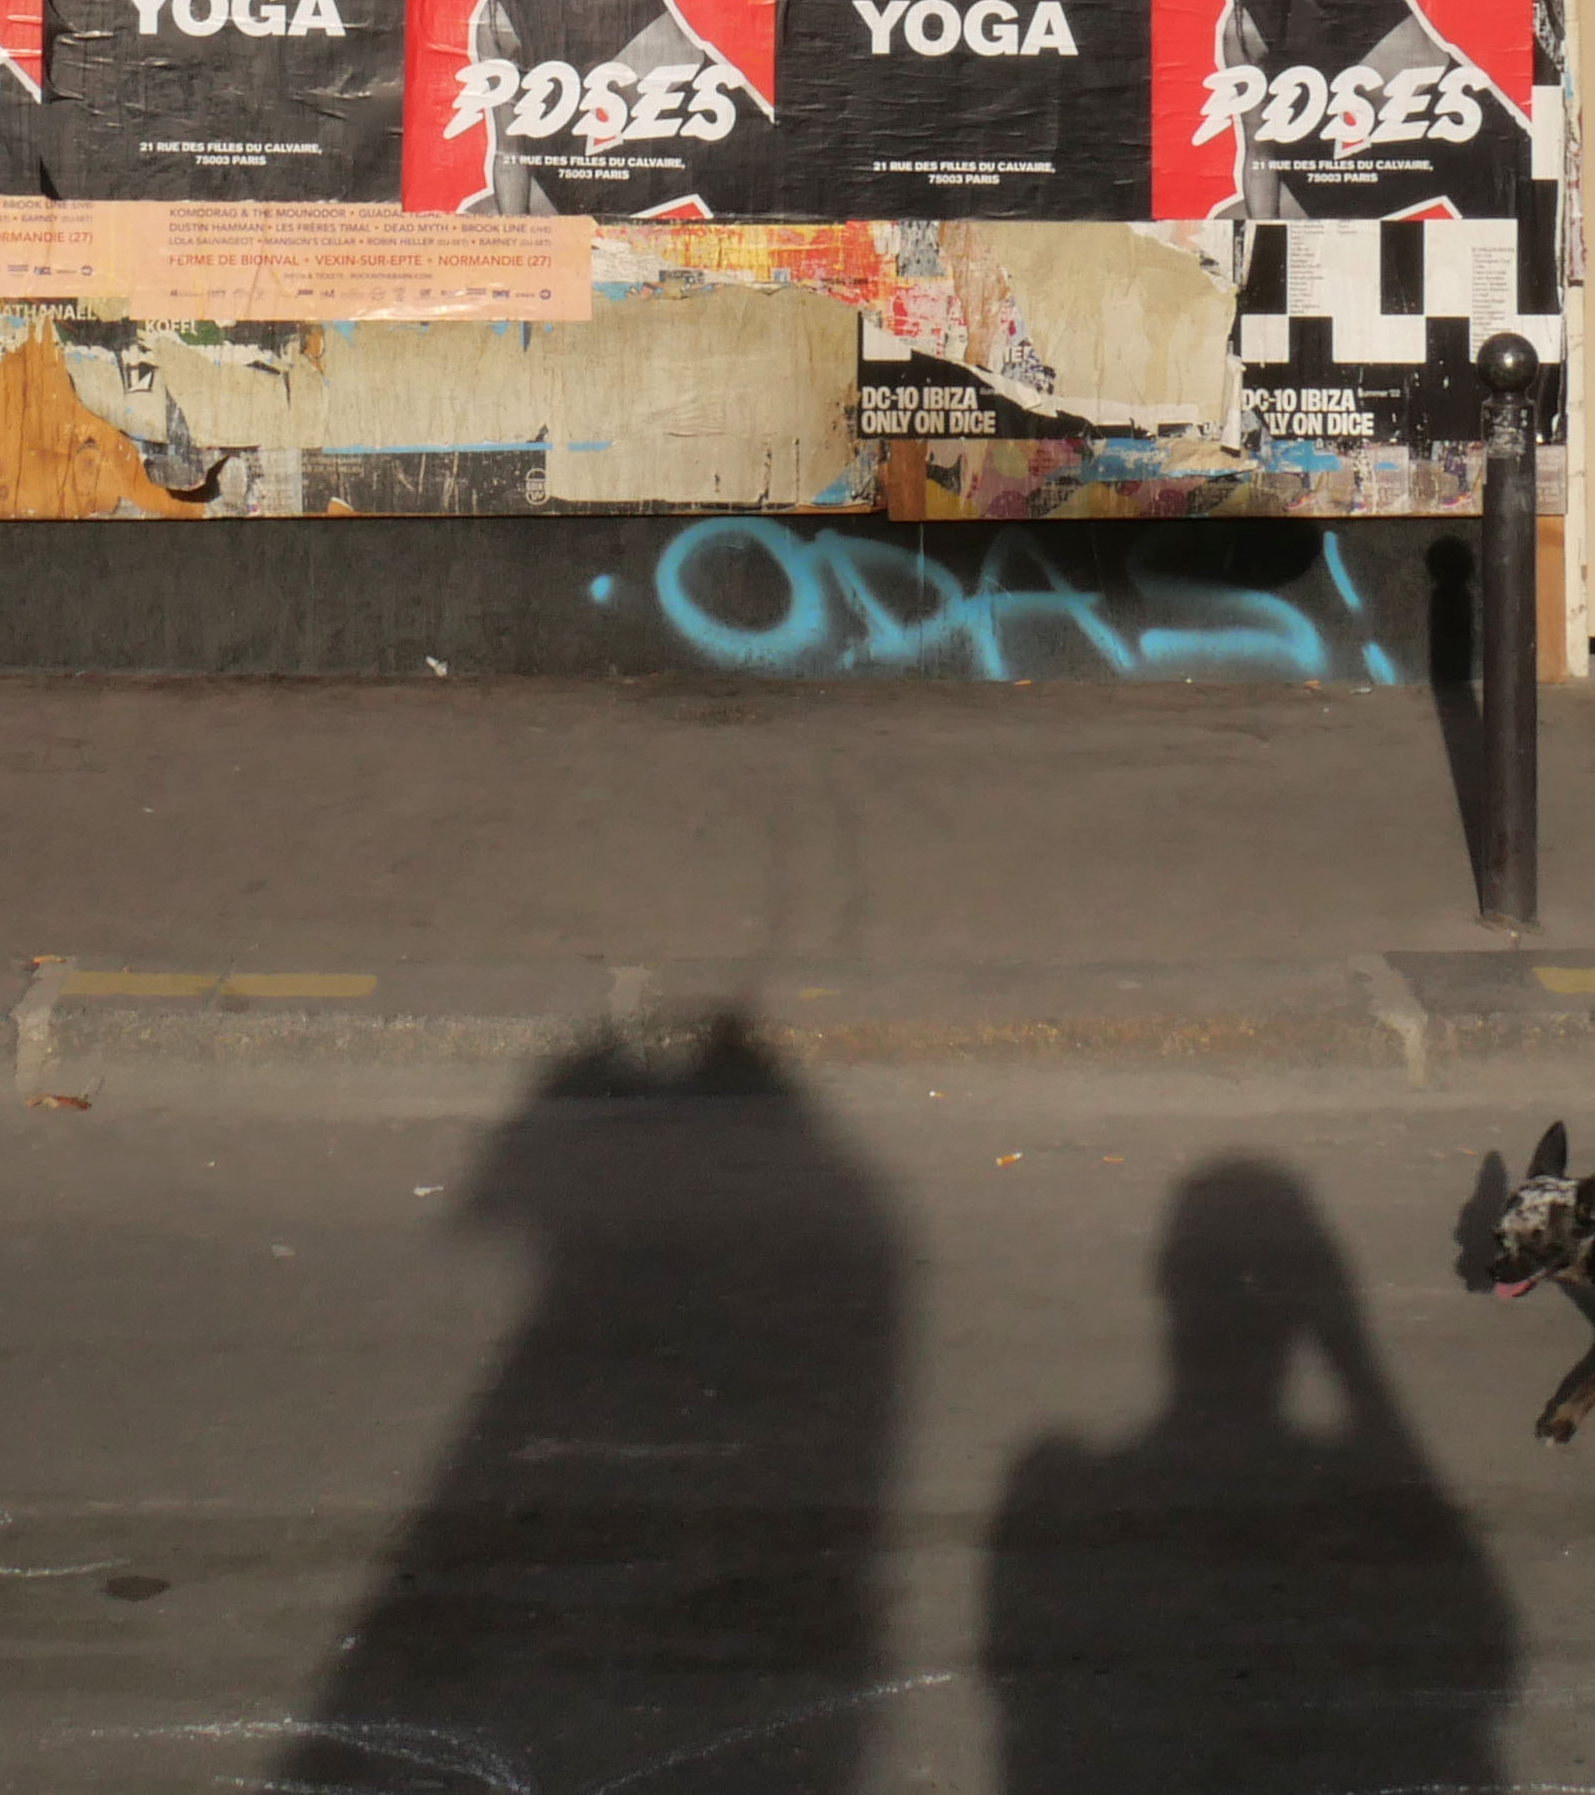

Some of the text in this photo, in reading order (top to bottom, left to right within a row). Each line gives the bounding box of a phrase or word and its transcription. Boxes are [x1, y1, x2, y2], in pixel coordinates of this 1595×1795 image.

[444, 60, 742, 143] POSES
[1192, 65, 1489, 146] POSES
[873, 161, 1056, 174] 21 RUE DES FILLES DU CALVAIRE,
[964, 174, 1000, 184] PARIS
[169, 254, 551, 269] FERME DE BIONVAL VEXIN-SUR-EPTE NORMANDIE (27)
[861, 386, 978, 410] DC-10 IBIZA
[1242, 388, 1356, 412] DC-10 IBIZA
[861, 410, 996, 434] ONLY ON DICE
[1292, 412, 1323, 436] ON
[1327, 412, 1375, 436] DICE
